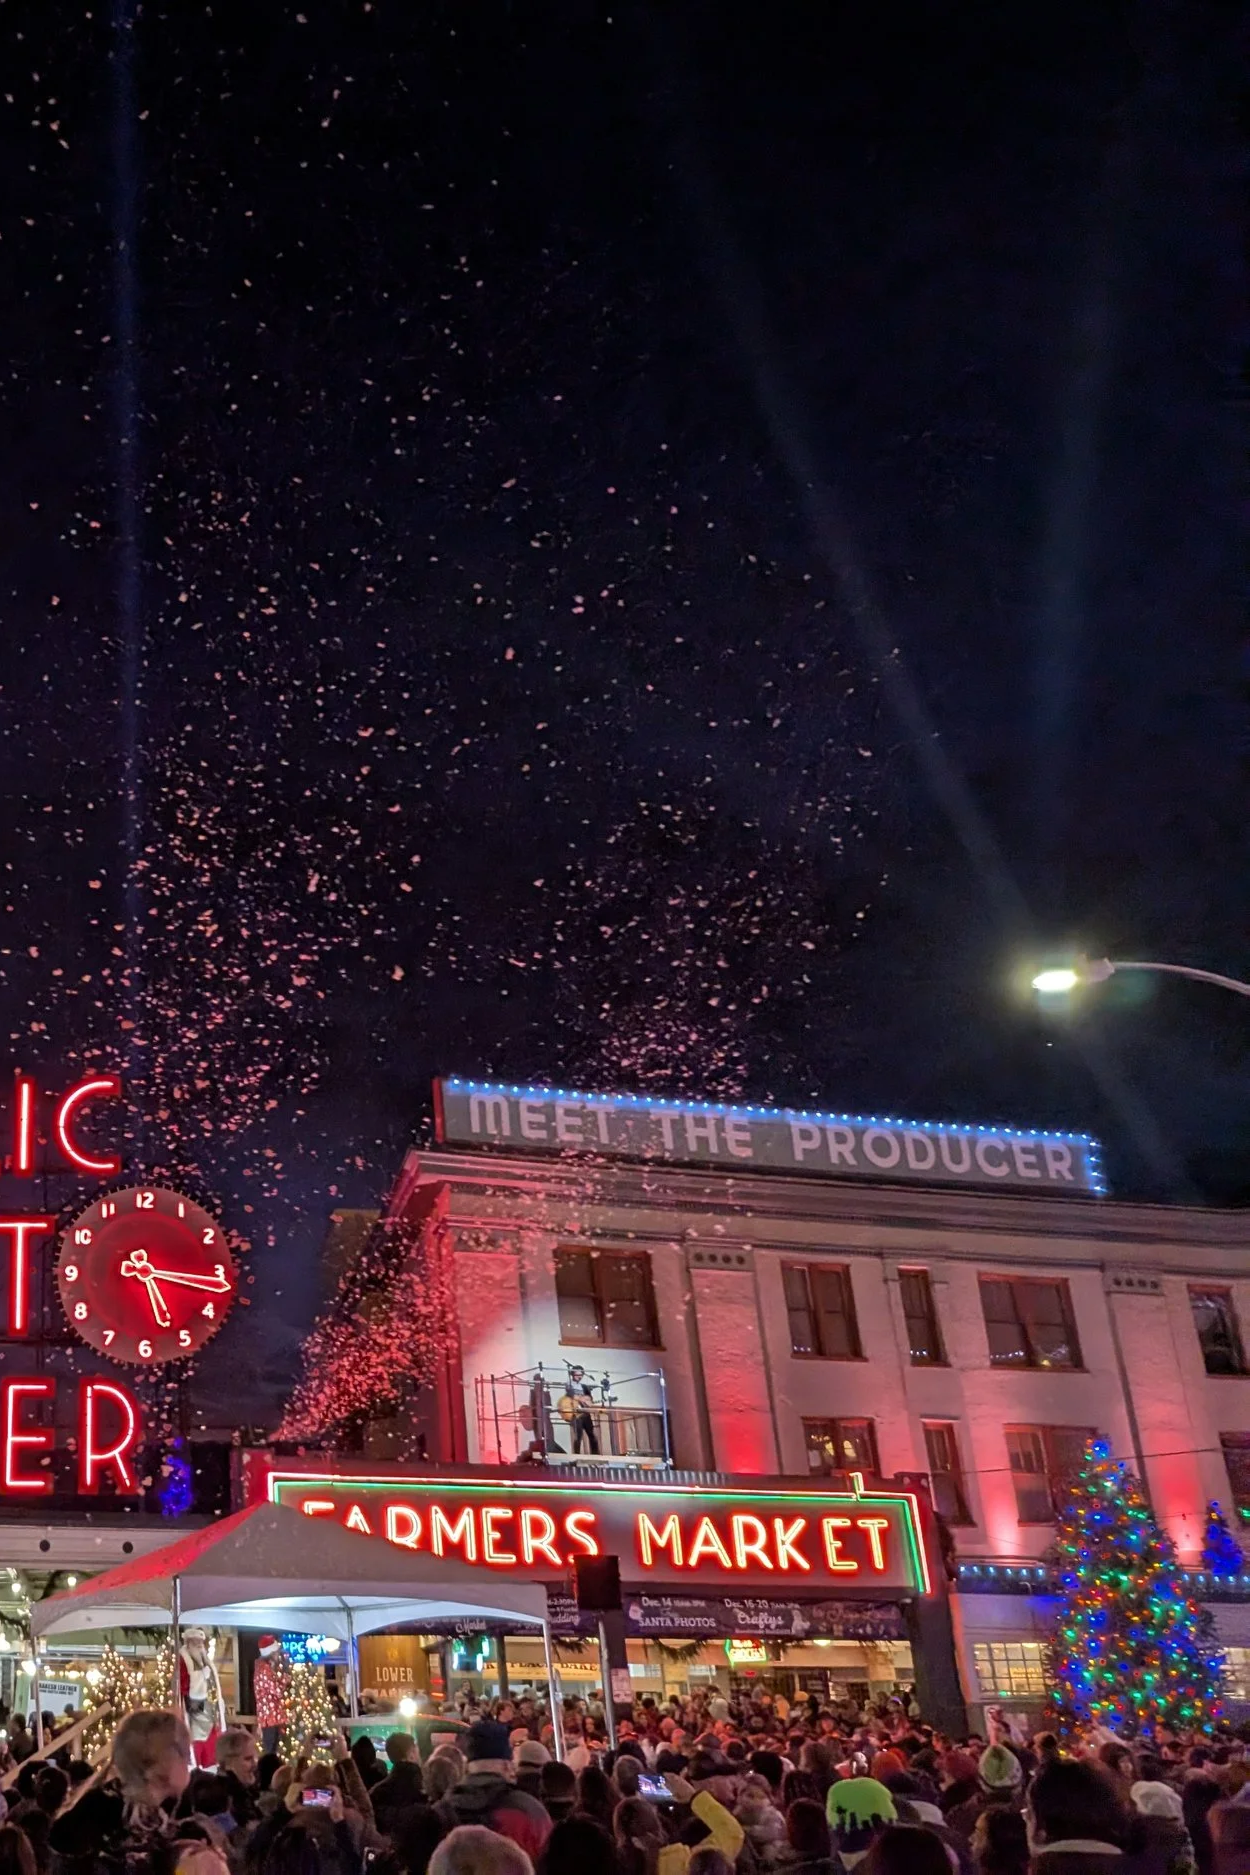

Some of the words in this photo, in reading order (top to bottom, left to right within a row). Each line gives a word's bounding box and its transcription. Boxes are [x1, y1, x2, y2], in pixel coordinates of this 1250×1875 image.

[470, 1092, 615, 1145] MEET
[655, 1107, 752, 1157] THE
[790, 1117, 1076, 1182] PRODUCER
[136, 1192, 154, 1208] 12
[102, 1203, 115, 1218] 11
[178, 1203, 185, 1218] 1
[75, 1229, 92, 1245] 10
[203, 1228, 215, 1244] 2
[65, 1265, 78, 1281] 9
[214, 1265, 225, 1280] 3
[75, 1302, 88, 1319] 8
[202, 1302, 215, 1319] 4
[103, 1330, 115, 1345] 7
[179, 1330, 191, 1346] 5
[138, 1340, 152, 1357] 6
[636, 1512, 891, 1573] MARKET
[641, 1596, 661, 1607] Dec.
[662, 1597, 672, 1607] 14
[638, 1617, 672, 1627] SANTA
[674, 1617, 717, 1628] PHOTOS
[375, 1666, 414, 1682] LOWER
